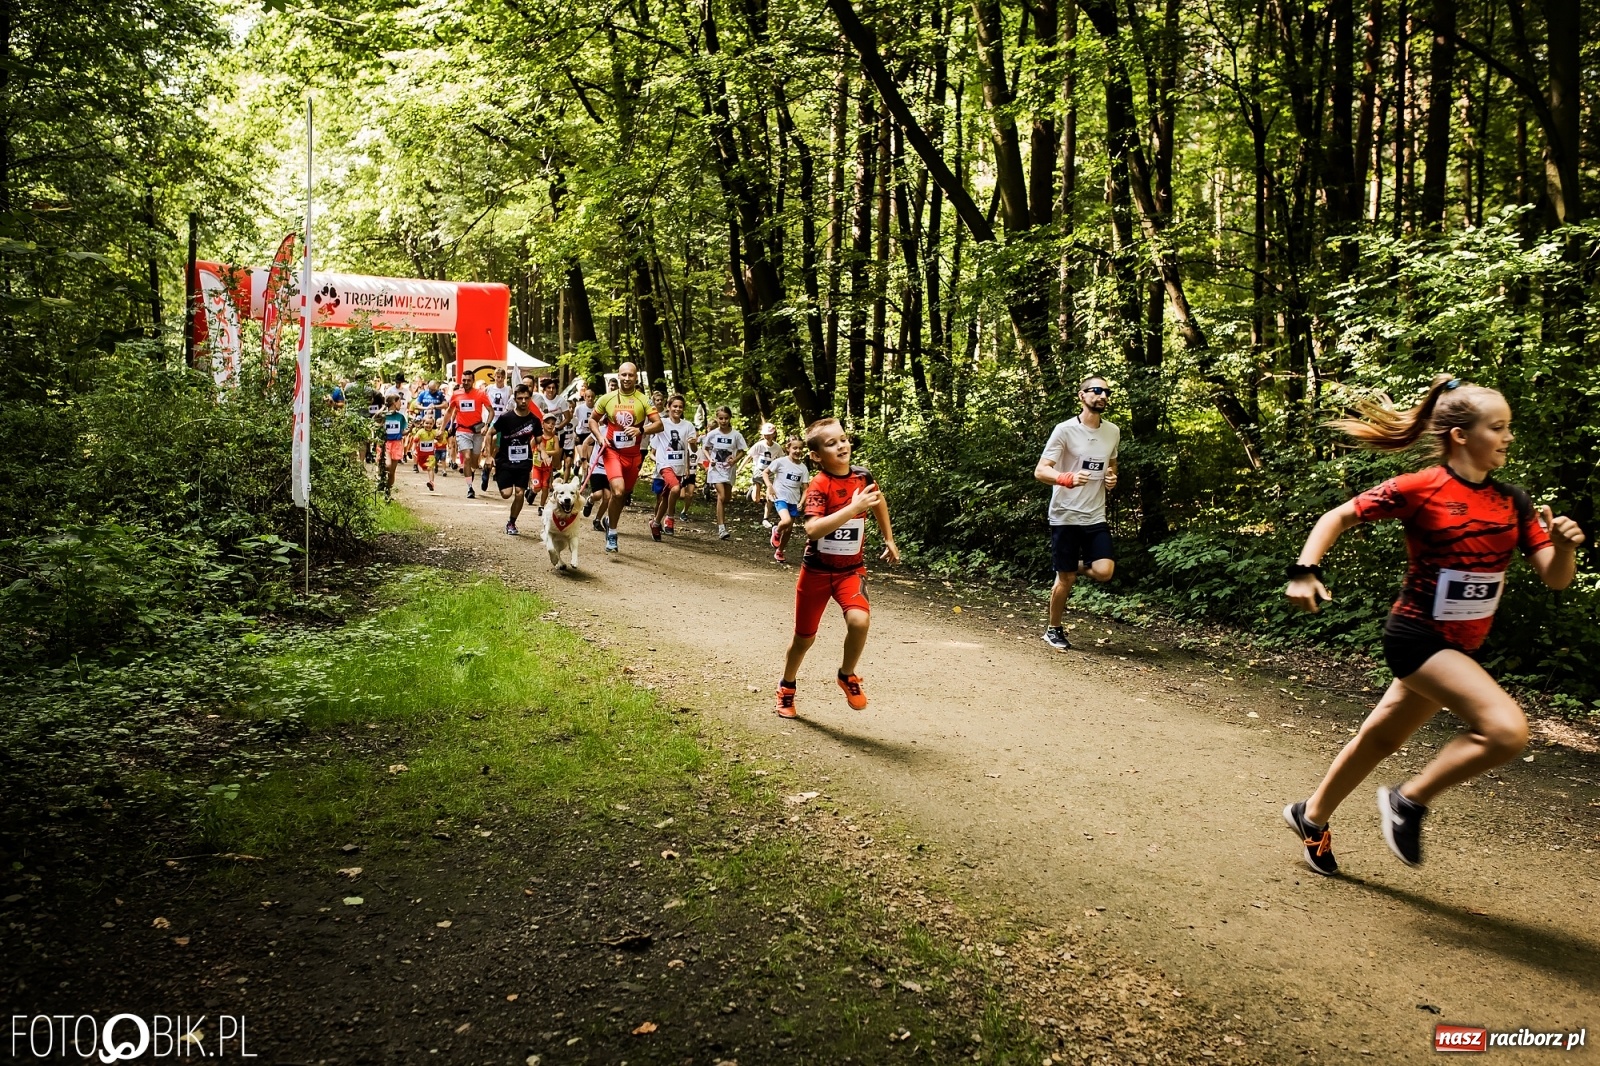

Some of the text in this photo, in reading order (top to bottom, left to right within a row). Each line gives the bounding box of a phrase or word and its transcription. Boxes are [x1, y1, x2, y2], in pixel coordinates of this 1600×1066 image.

[1088, 462, 1100, 470] 62
[834, 529, 851, 540] 82
[1463, 584, 1489, 598] 83
